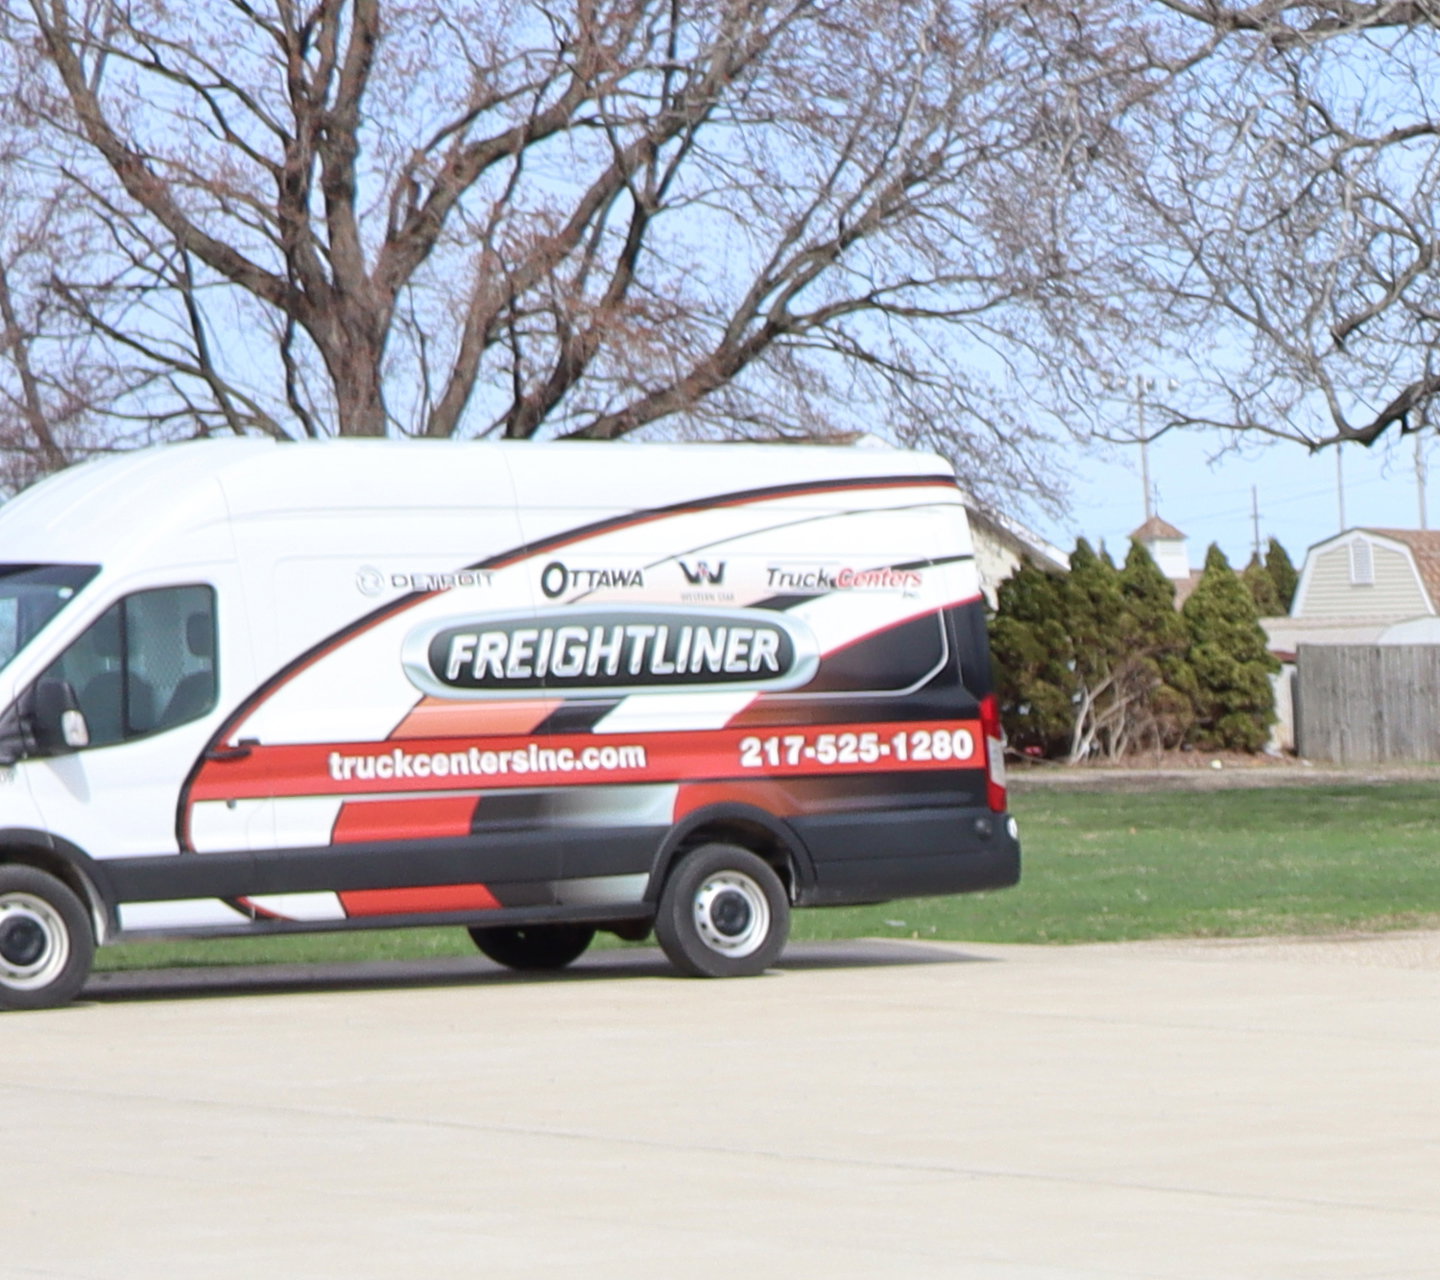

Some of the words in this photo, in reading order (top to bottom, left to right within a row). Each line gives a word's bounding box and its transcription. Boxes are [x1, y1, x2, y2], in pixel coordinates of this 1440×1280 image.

[391, 569, 495, 590] DETROIT
[541, 561, 645, 598] OTTAWA
[766, 567, 829, 588] Truck
[835, 566, 923, 589] Centers
[446, 625, 780, 681] FREIGHTLINER
[328, 744, 647, 781] truckcentersinc.com
[739, 728, 975, 768] 217-525-1280
